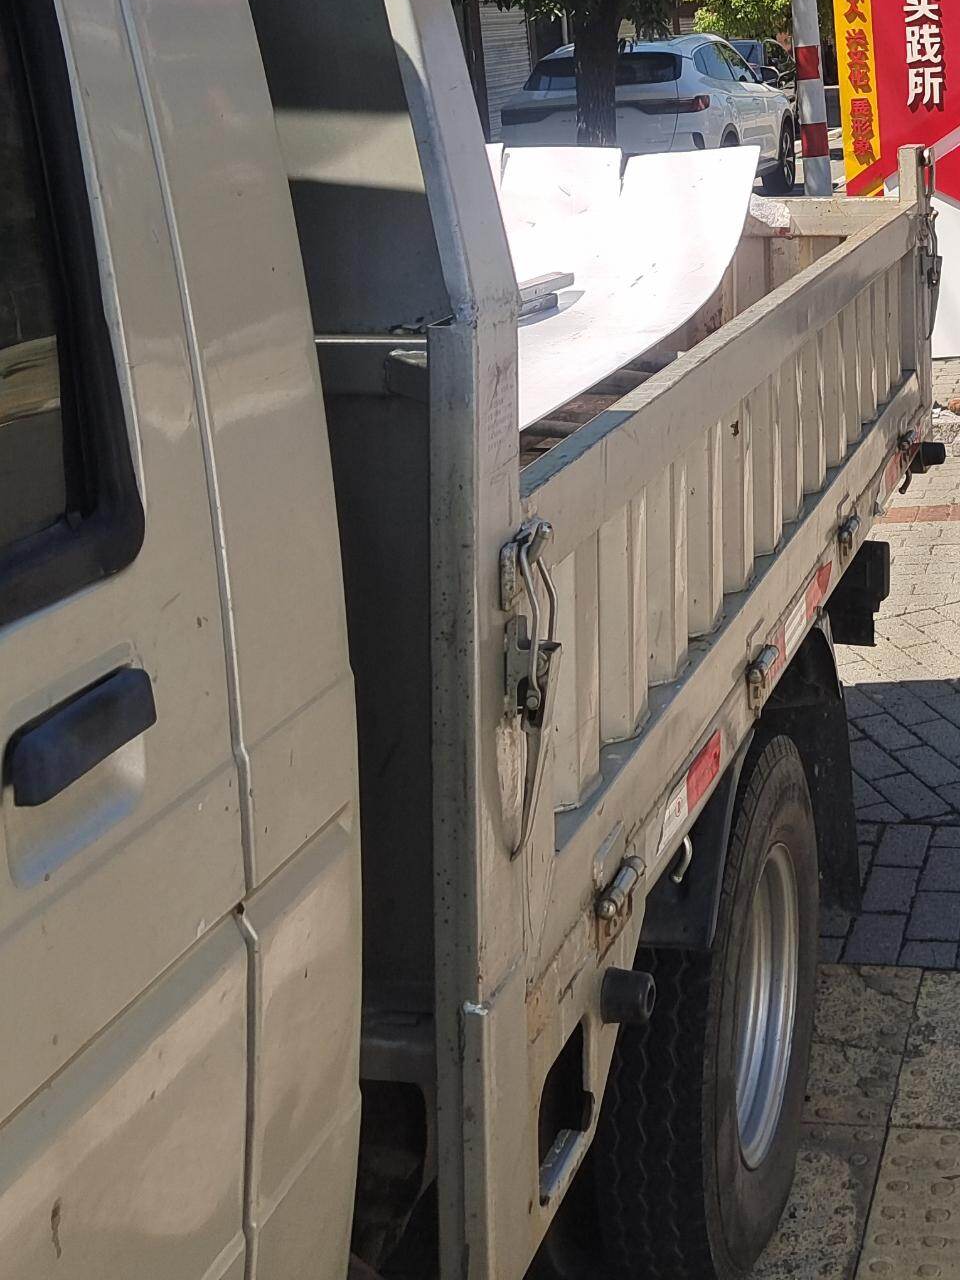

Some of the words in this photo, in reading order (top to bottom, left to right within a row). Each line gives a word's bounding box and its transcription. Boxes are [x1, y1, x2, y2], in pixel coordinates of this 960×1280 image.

[845, 29, 871, 93] 兴文化
[850, 98, 875, 164] 展形象
